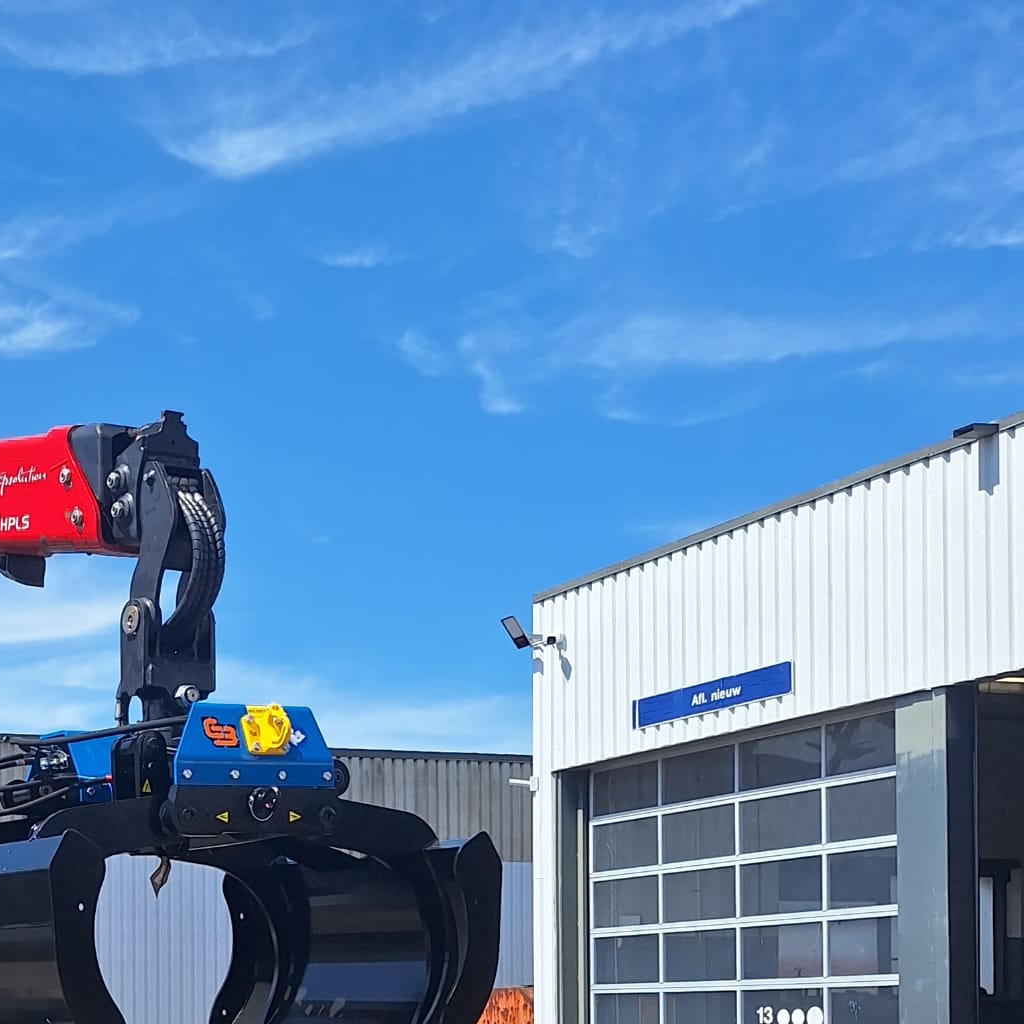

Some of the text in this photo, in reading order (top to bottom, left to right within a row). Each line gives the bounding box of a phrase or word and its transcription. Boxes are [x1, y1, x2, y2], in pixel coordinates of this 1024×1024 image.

[691, 685, 742, 706] Afl. nieuw
[756, 1006, 774, 1024] 13
